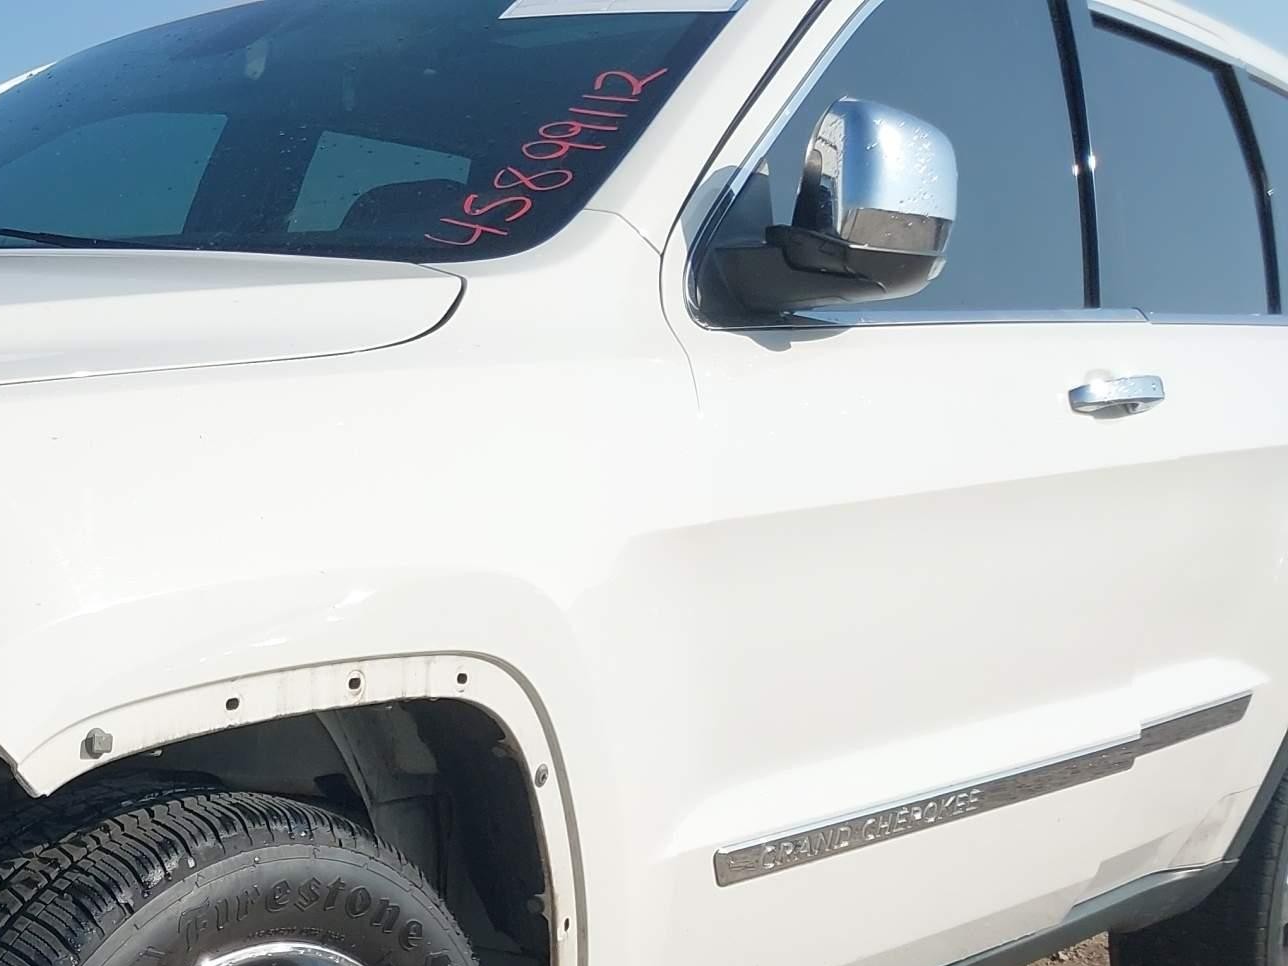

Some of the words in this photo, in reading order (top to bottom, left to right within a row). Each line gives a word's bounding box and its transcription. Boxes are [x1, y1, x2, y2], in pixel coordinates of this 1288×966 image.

[424, 67, 668, 246] 45899112
[758, 826, 852, 871] GRAND
[861, 788, 984, 843] CHEROKEE
[176, 876, 425, 951] Firestone
